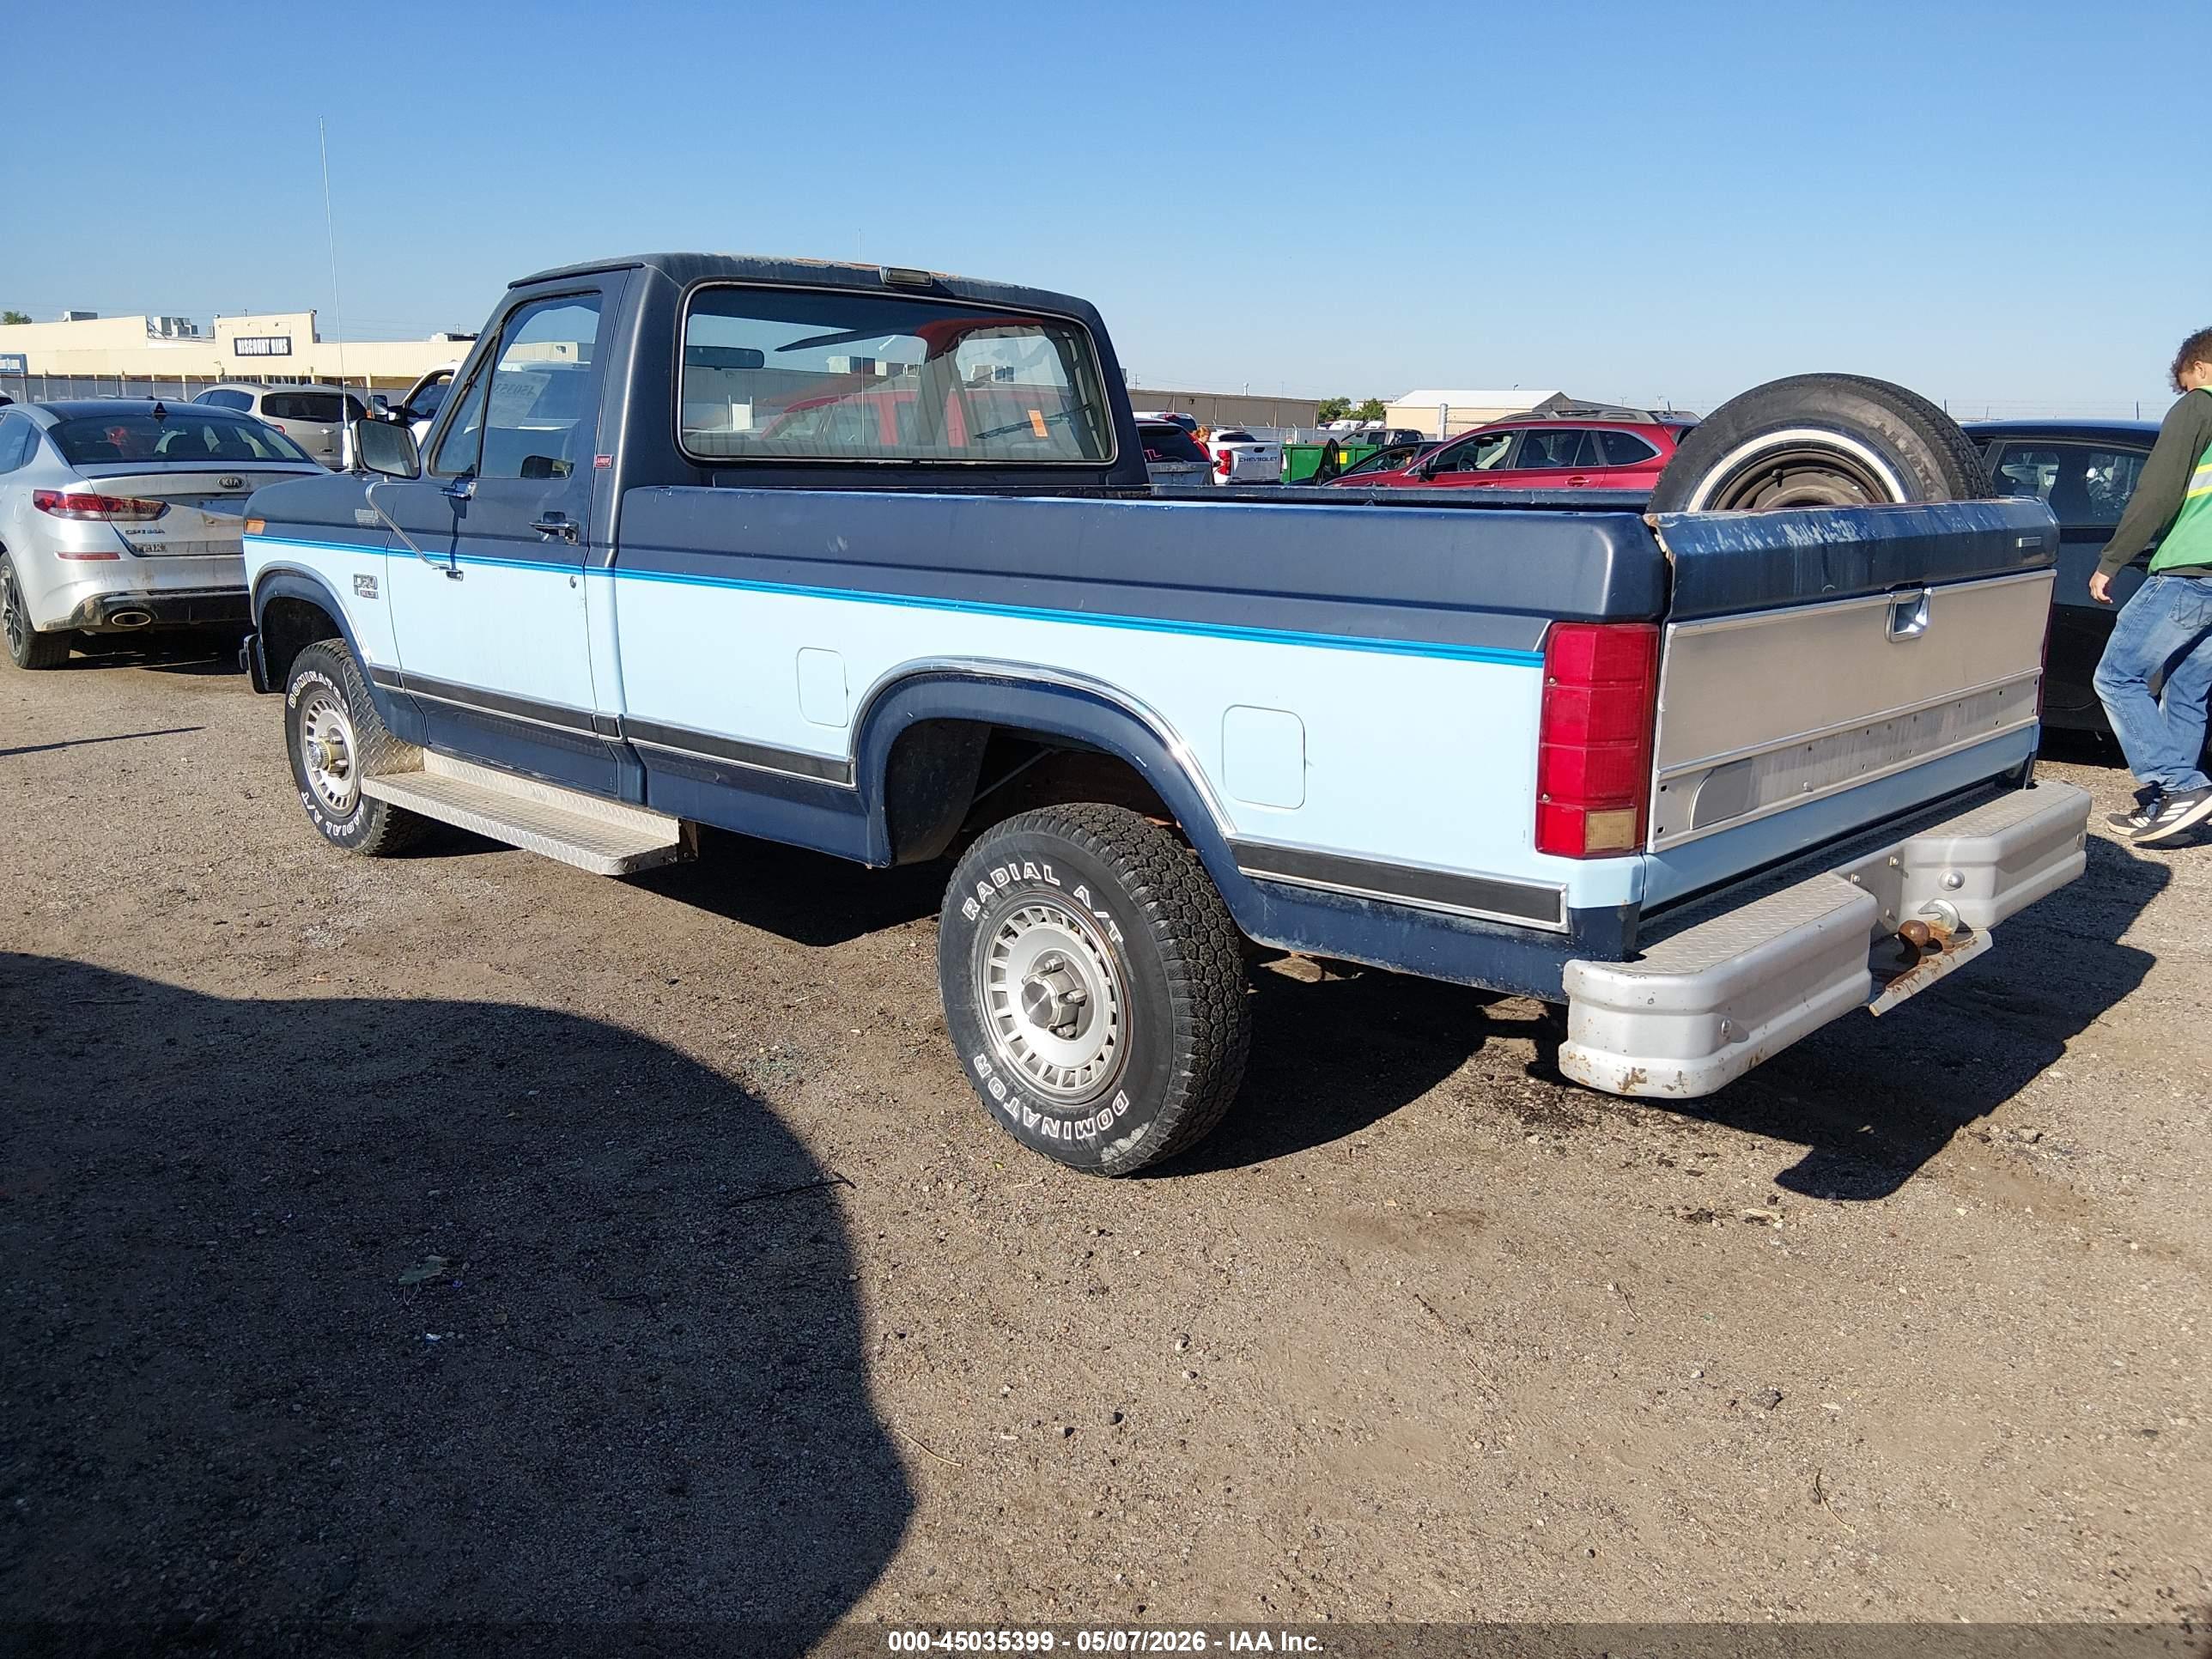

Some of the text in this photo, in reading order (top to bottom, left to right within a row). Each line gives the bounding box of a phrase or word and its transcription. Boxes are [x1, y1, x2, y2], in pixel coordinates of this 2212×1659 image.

[236, 337, 289, 355] DISCOUNT BINS
[221, 477, 240, 487] KIA
[289, 671, 349, 714] DOMINATOR
[301, 792, 323, 823] A/T
[962, 861, 1124, 945] RADIAL A/T
[974, 1053, 1129, 1140] DOMINATOR
